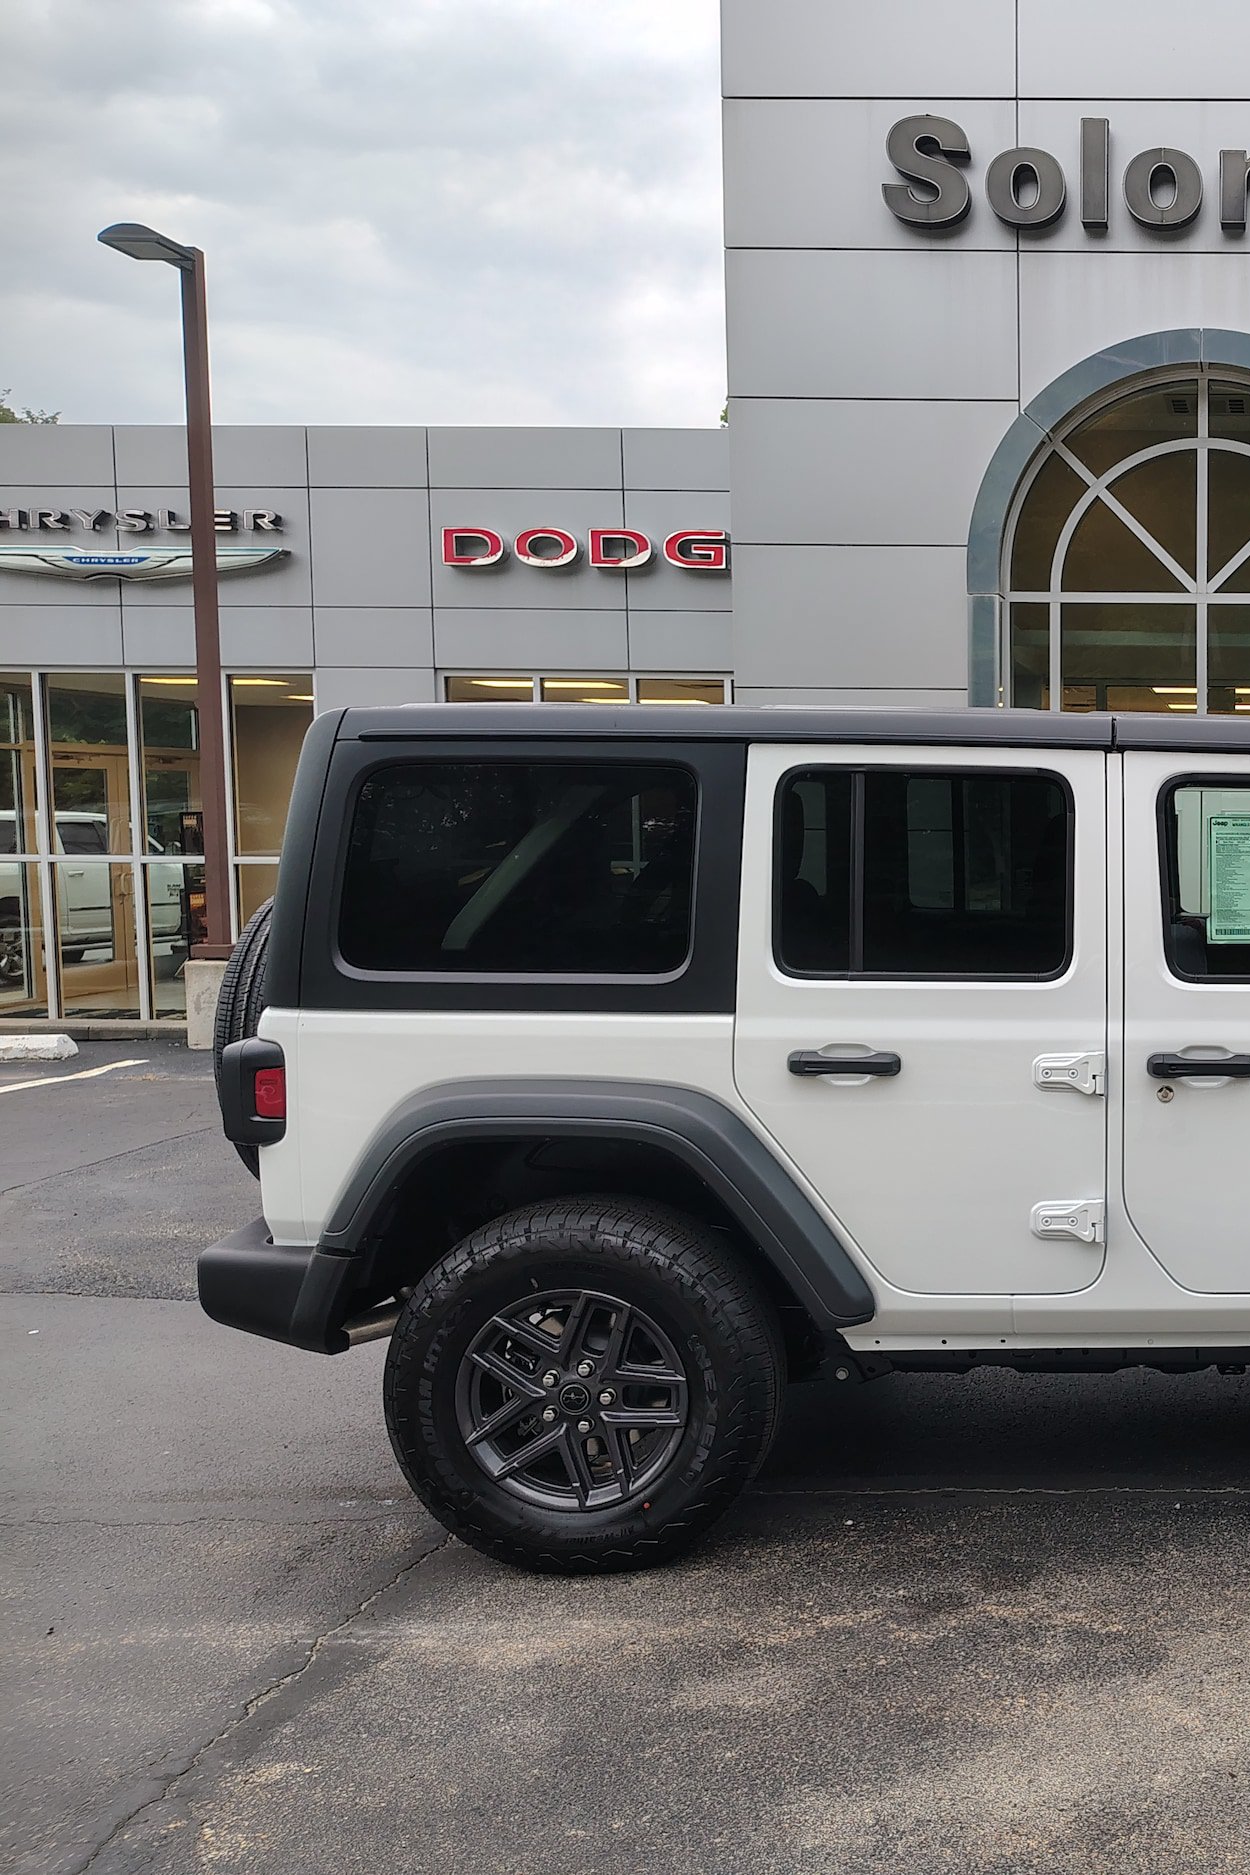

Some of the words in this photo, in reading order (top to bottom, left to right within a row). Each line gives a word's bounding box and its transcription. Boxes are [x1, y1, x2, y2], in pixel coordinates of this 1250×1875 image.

[72, 556, 140, 564] CHRYSLER
[441, 527, 731, 570] DODG
[690, 1342, 719, 1473] NEXEN
